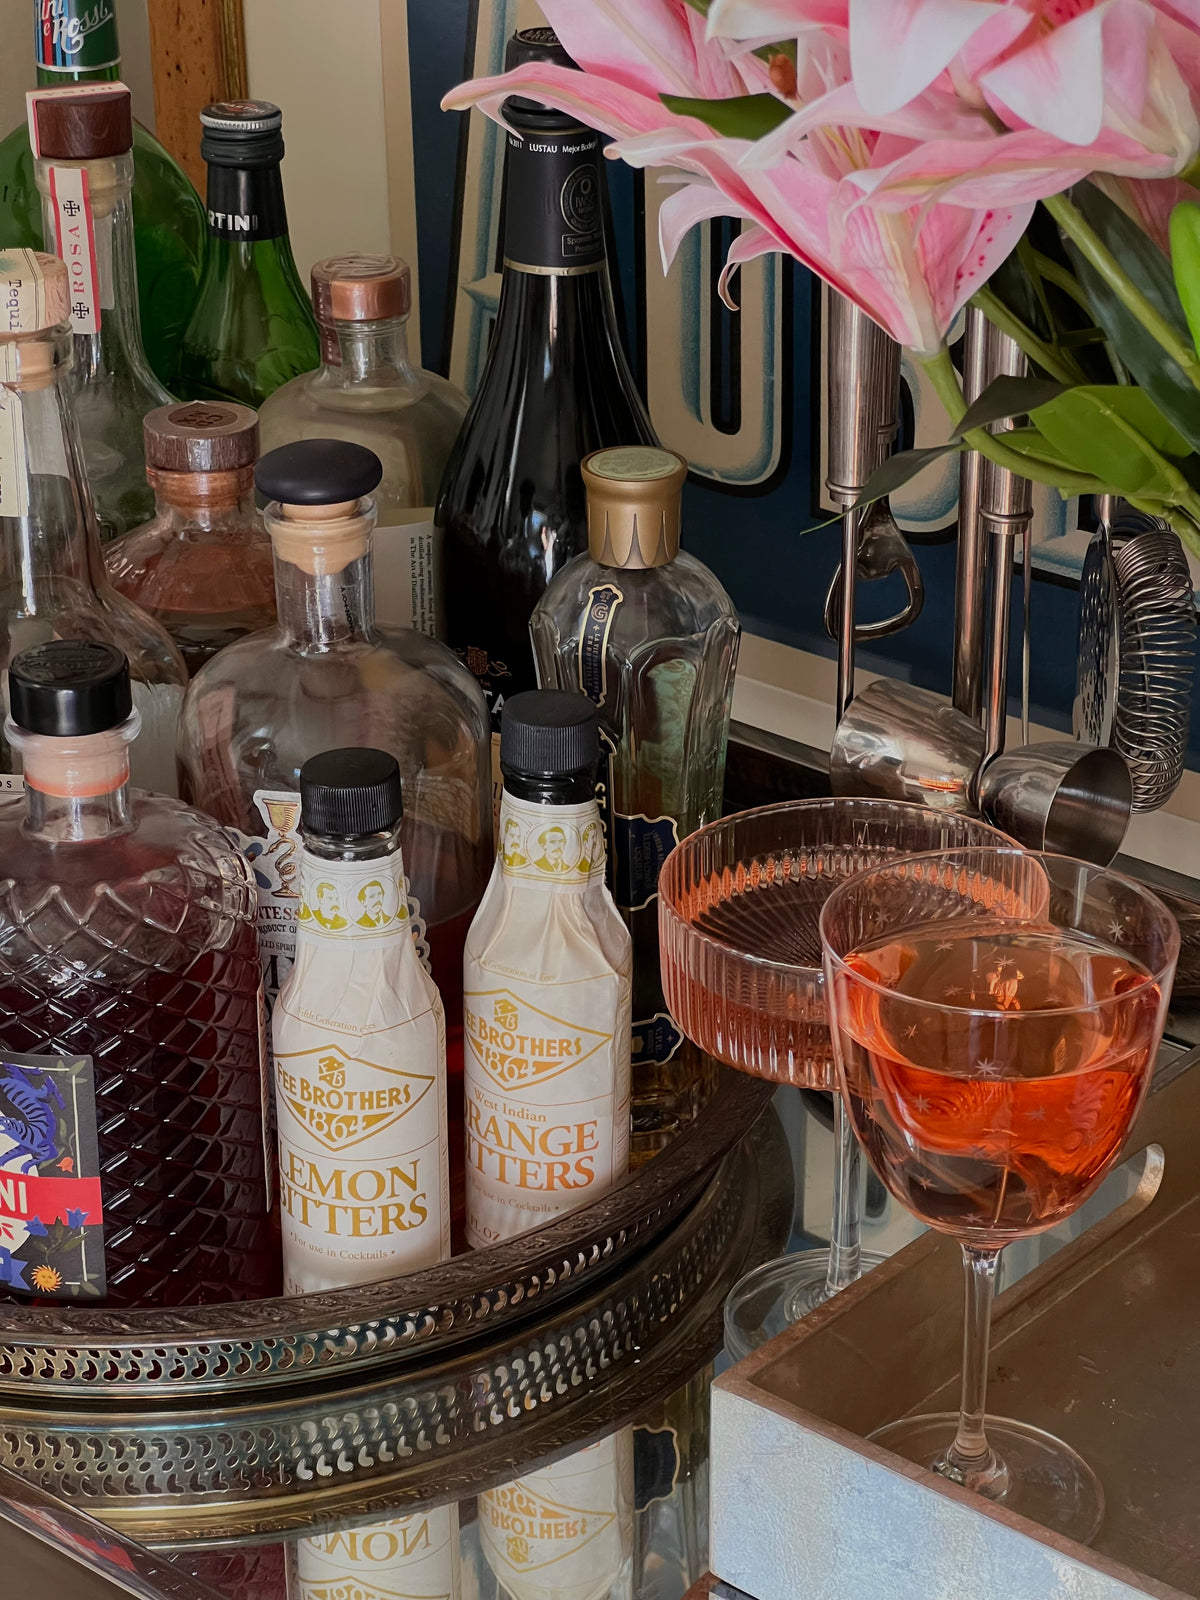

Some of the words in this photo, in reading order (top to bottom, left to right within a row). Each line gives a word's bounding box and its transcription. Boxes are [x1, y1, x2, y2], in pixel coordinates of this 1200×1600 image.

[529, 143, 558, 154] LUSTAU
[562, 145, 580, 155] Mejor
[68, 225, 85, 294] ROSA
[6, 279, 23, 331] Tequi
[478, 1016, 583, 1057] BROTHERS
[481, 1047, 537, 1081] 1864
[277, 1061, 297, 1096] FEE
[300, 1084, 411, 1111] BROTHERS
[474, 1087, 499, 1111] West
[502, 1103, 547, 1122] Indian
[303, 1108, 368, 1141] 1864
[280, 1139, 421, 1202] LEMON
[465, 1129, 595, 1191] ITTERS
[508, 1199, 552, 1213] Cocktails
[308, 1244, 324, 1254] use
[327, 1247, 337, 1257] in
[339, 1250, 388, 1261] Cocktails
